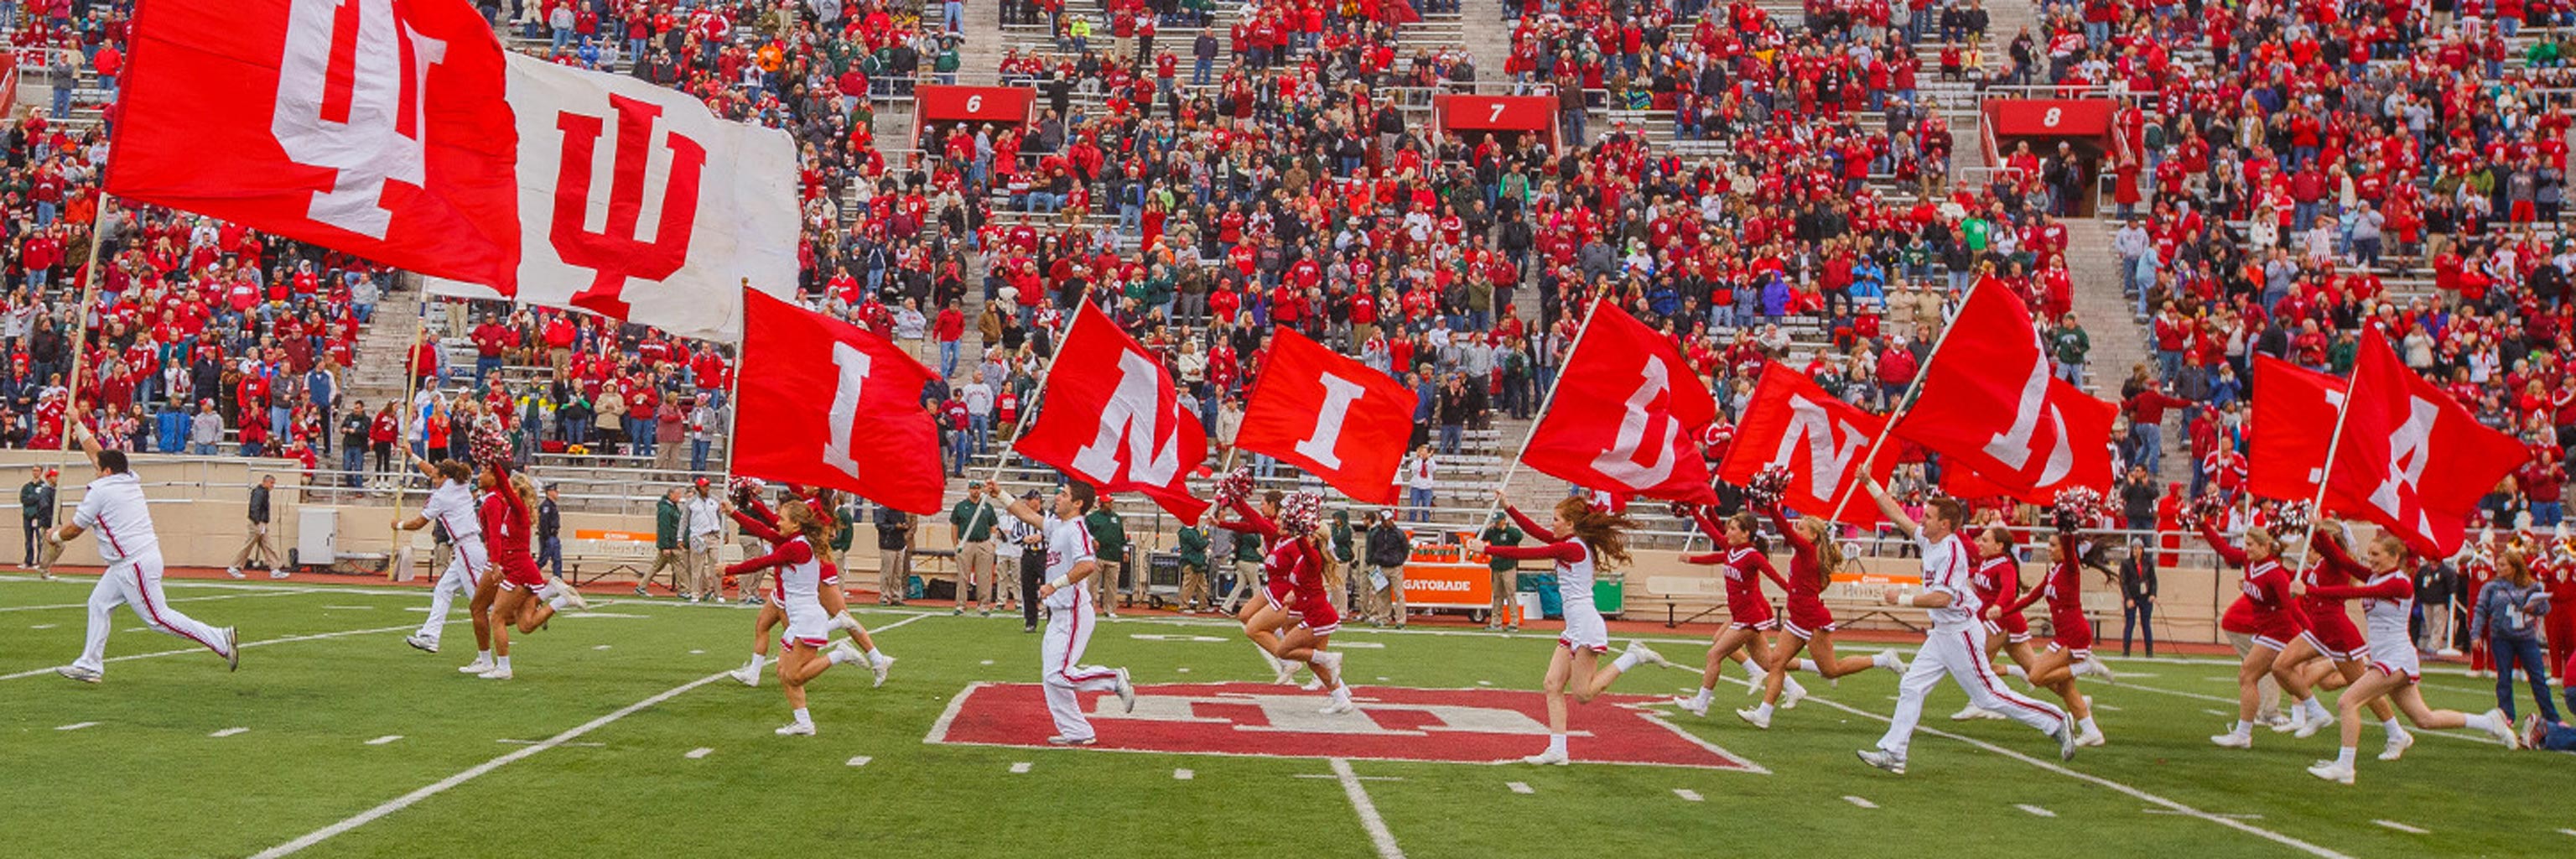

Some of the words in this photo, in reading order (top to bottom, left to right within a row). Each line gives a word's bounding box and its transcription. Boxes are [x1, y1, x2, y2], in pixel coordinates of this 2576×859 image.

[967, 95, 982, 113] 6
[1489, 103, 1505, 122] 7
[2044, 107, 2061, 127] 8
[823, 341, 872, 480] I
[1071, 347, 1180, 488] N
[1294, 371, 1366, 471] I
[1763, 393, 1870, 502] N
[2368, 394, 2440, 550] A
[1402, 580, 1472, 591] GATORADE
